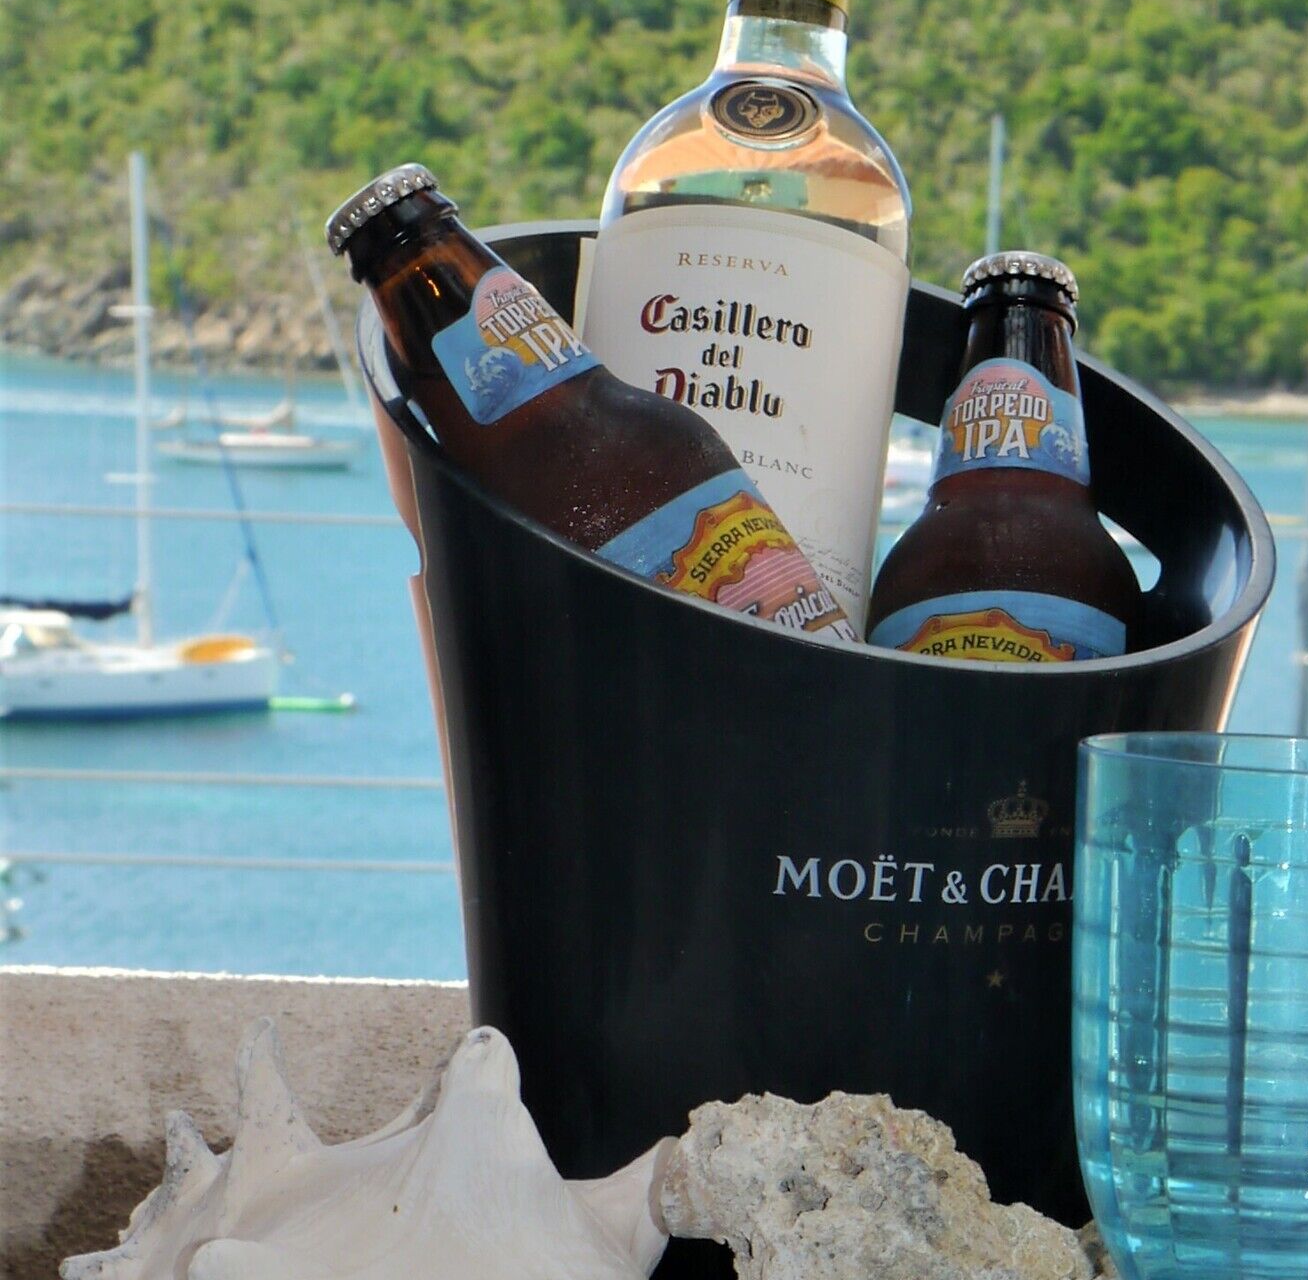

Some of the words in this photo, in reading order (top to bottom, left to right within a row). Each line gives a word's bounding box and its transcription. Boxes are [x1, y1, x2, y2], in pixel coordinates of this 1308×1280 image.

[678, 252, 788, 276] RESERVA
[640, 293, 812, 349] Casillero
[519, 320, 590, 372] IPA
[702, 343, 743, 370] del
[953, 393, 1049, 425] TORPEDO
[963, 419, 1031, 462] IPA
[742, 450, 814, 480] BLANC
[690, 527, 745, 584] SIERRA
[962, 633, 1043, 663] NEVADA
[772, 853, 935, 904] MOËT
[941, 870, 969, 905] &
[979, 862, 1074, 905] CHA
